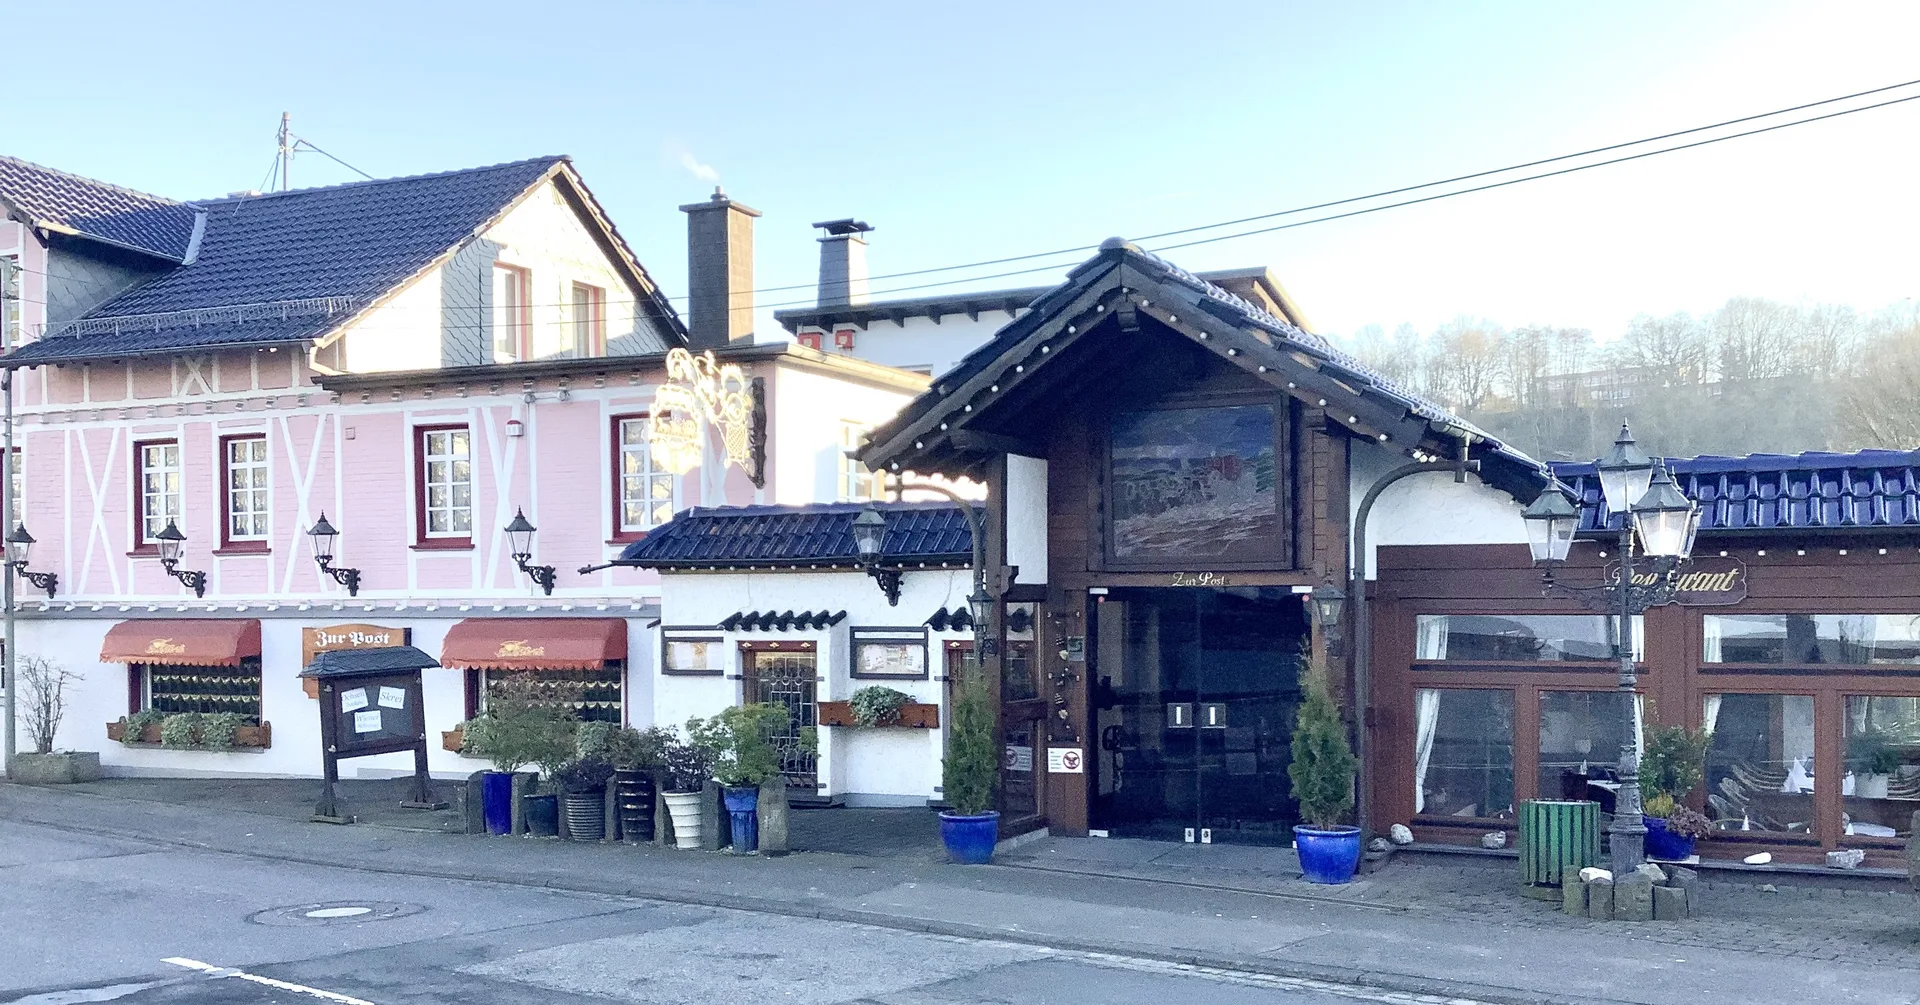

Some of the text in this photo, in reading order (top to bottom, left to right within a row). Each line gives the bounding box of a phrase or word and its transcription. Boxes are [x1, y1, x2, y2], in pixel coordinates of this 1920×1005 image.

[1171, 571, 1225, 586] Zur Post
[1611, 563, 1740, 592] Resurant
[314, 629, 390, 647] Zur Post
[380, 691, 403, 703] Skrei
